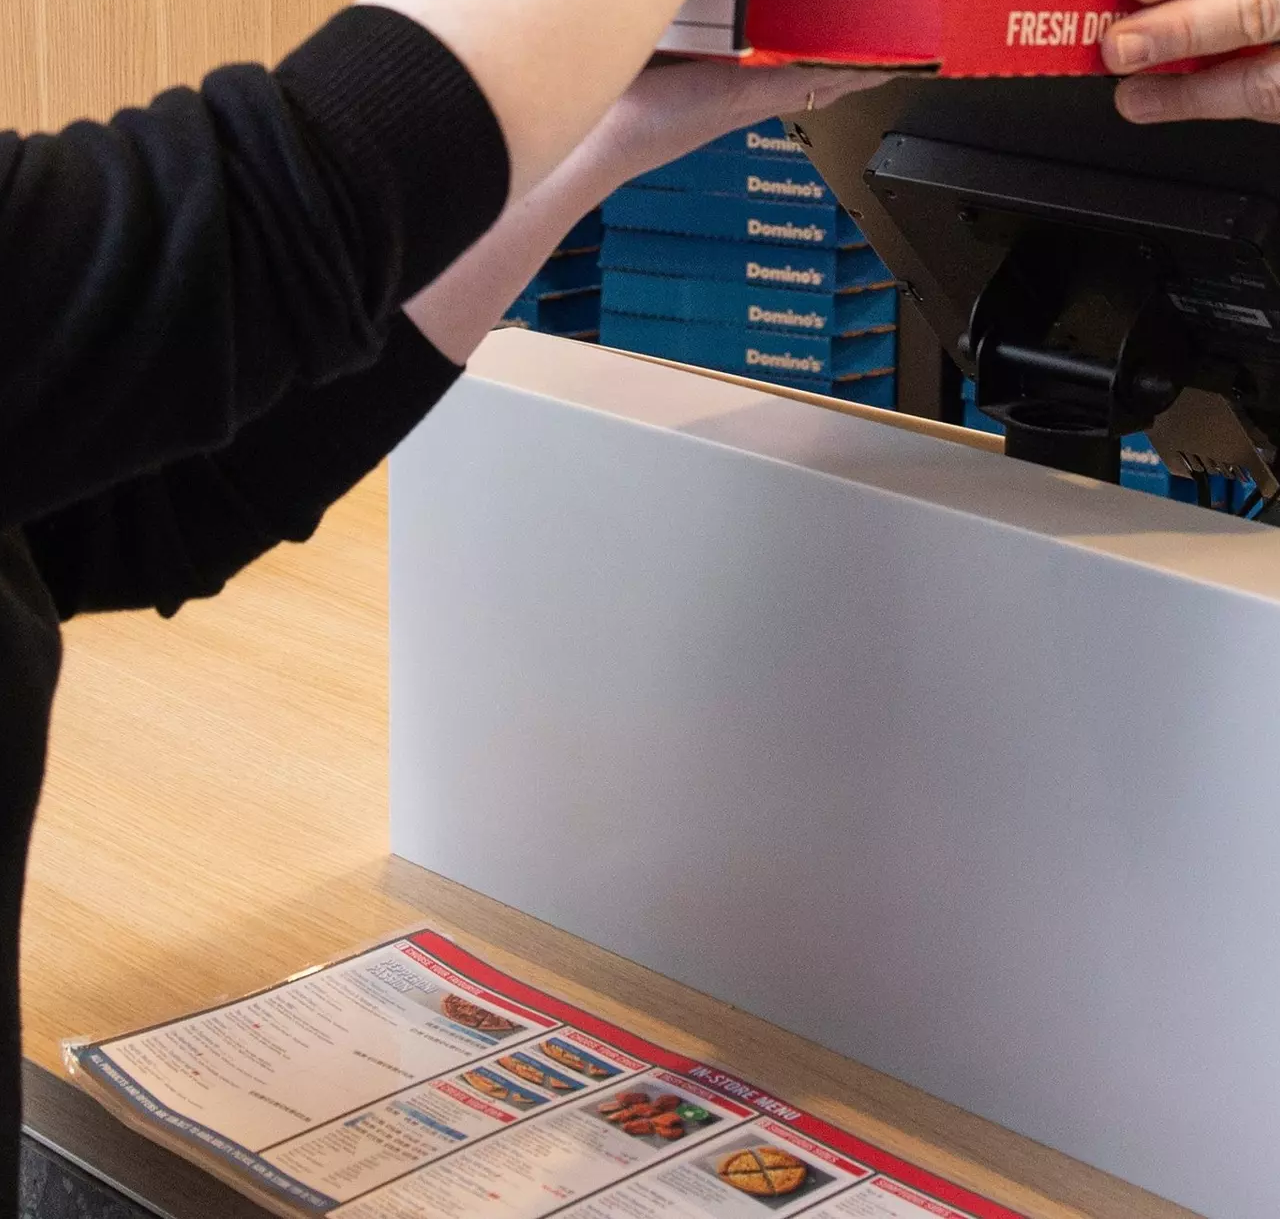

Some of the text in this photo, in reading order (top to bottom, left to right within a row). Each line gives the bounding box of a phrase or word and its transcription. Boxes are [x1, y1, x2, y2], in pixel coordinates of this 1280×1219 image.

[1006, 10, 1079, 46] FRESH
[747, 176, 824, 198] Domino's
[747, 219, 827, 242] Domino's
[746, 262, 824, 285] Domino's
[748, 305, 826, 329] Domino's
[746, 349, 824, 373] Domino's
[688, 1066, 759, 1101] IN-STORE
[753, 1096, 802, 1121] MENU
